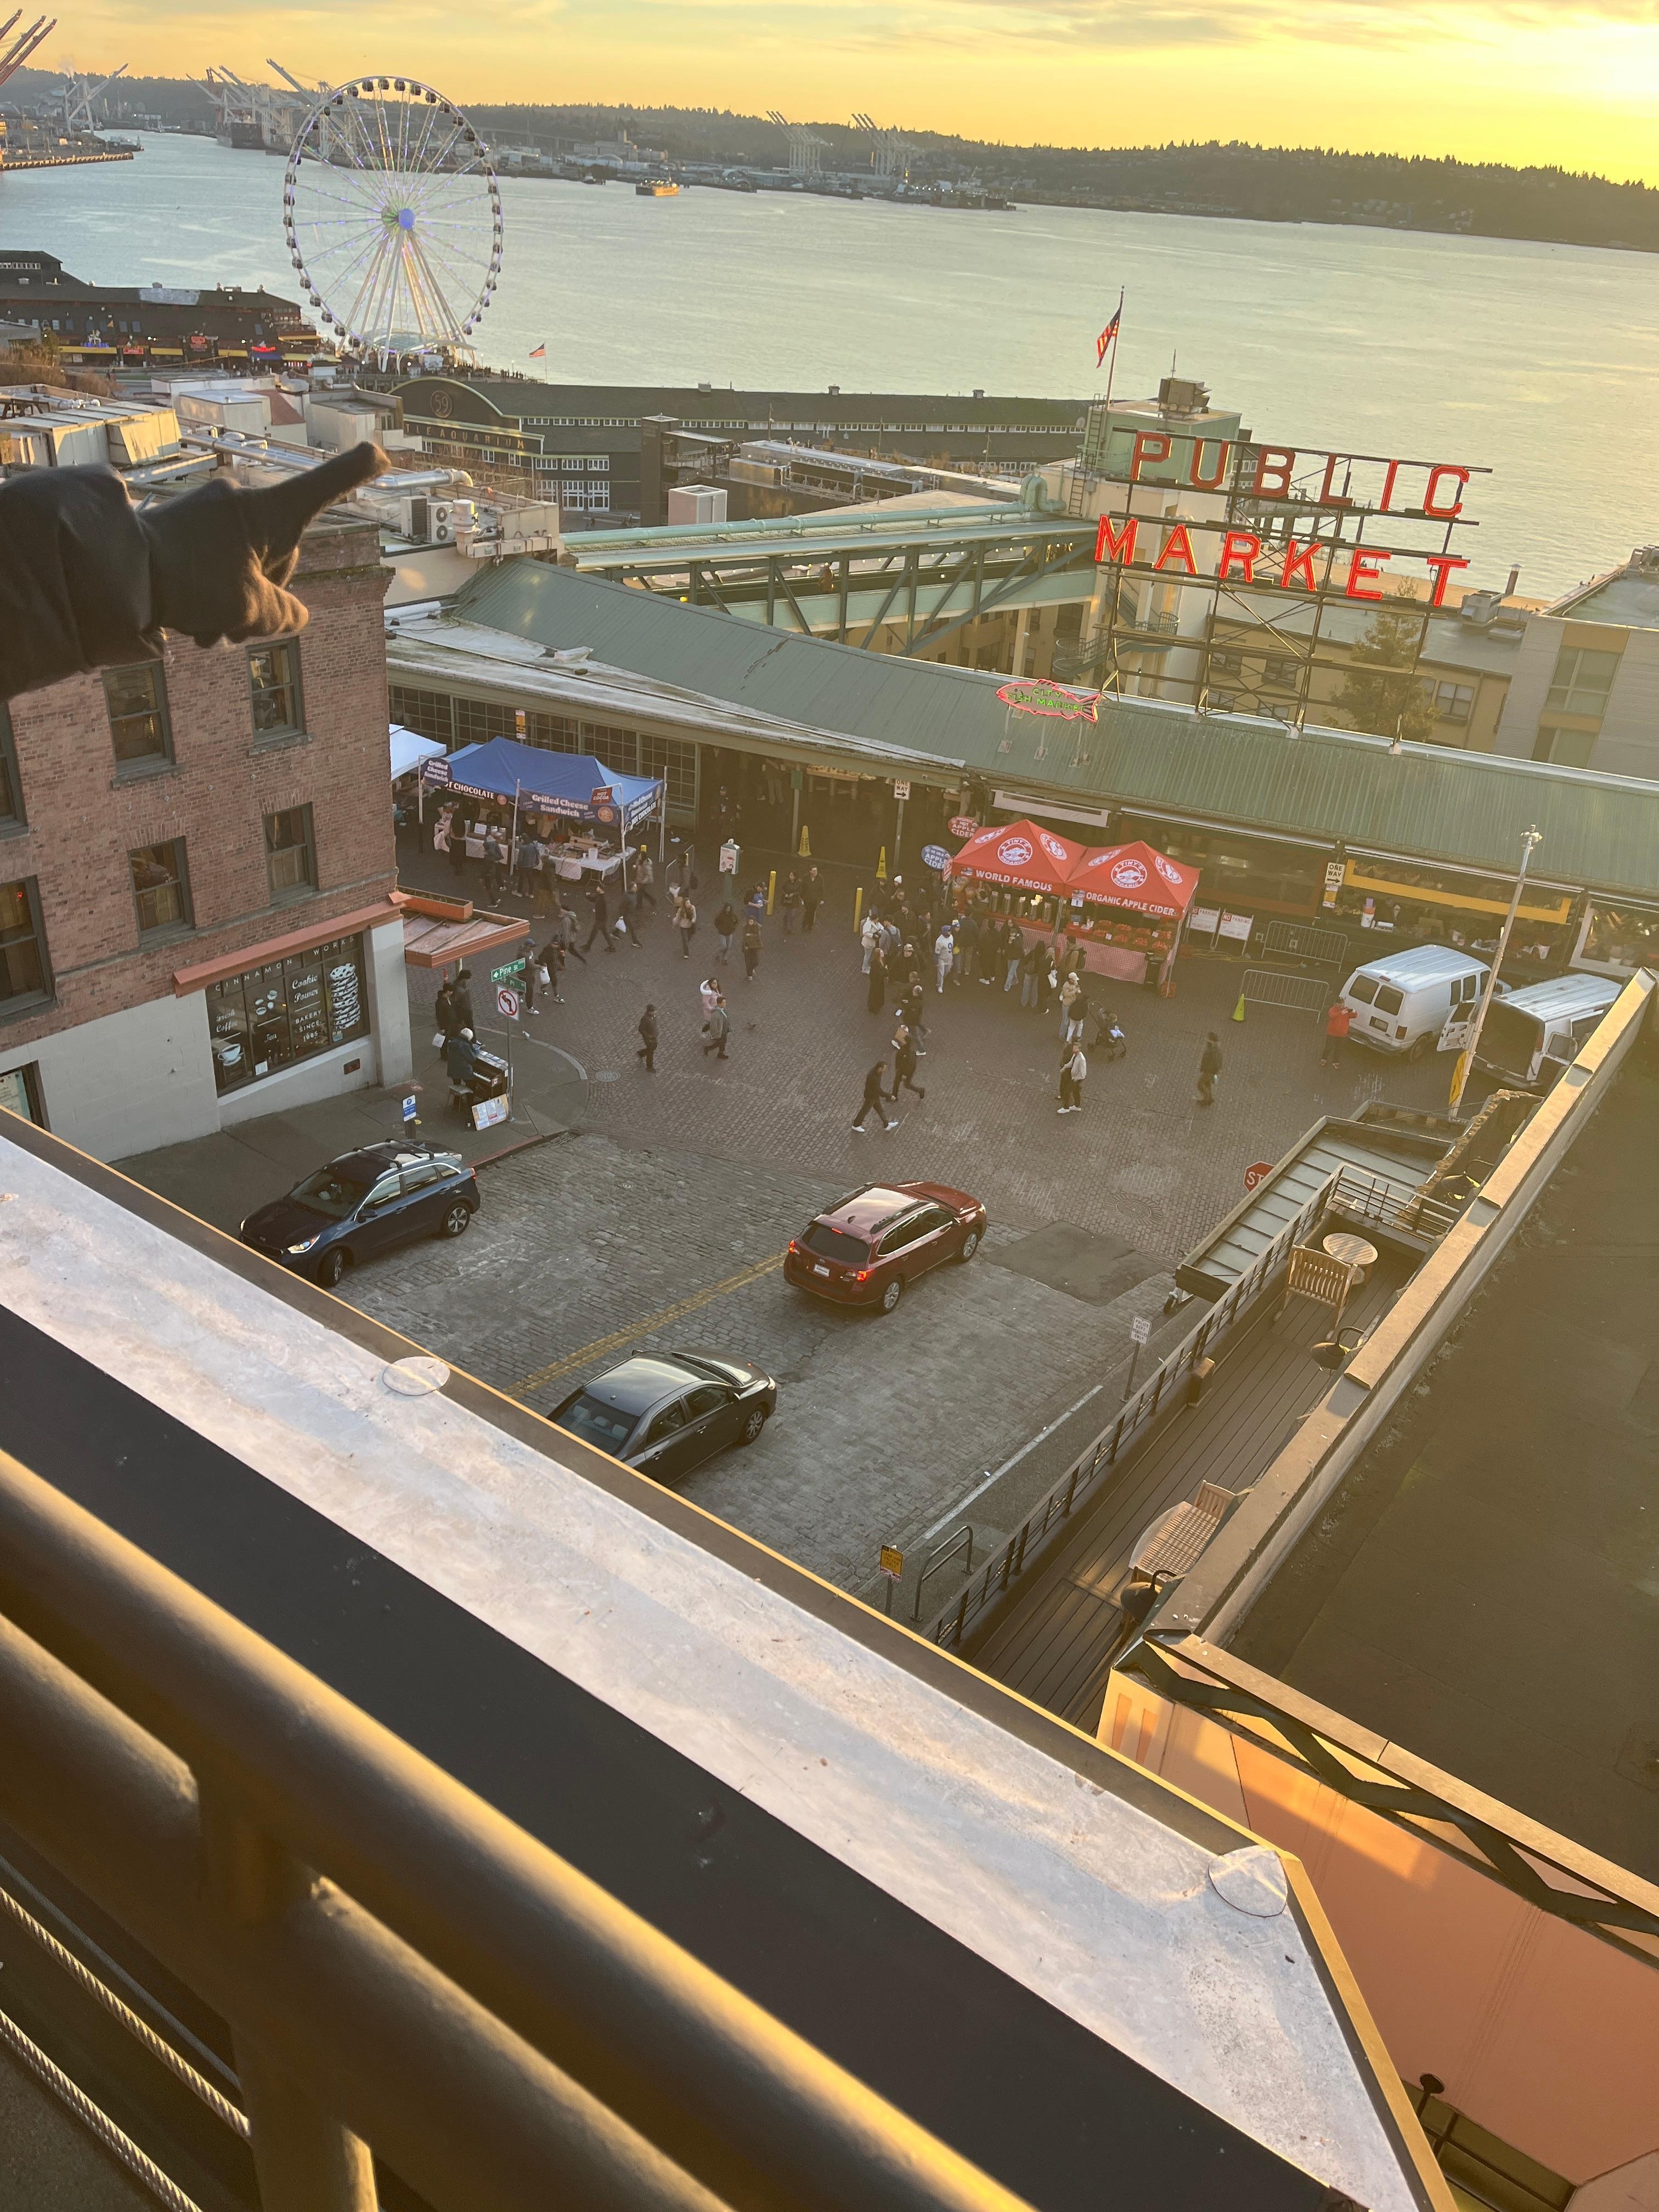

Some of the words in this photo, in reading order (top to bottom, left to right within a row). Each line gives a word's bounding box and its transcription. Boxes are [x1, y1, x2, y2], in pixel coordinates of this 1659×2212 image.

[435, 395, 449, 413] 59
[440, 428, 524, 449] AQUARIUM
[1131, 431, 1470, 518] PUBLIC
[1094, 514, 1469, 607] MARKET
[1006, 693, 1032, 703] FISH
[1032, 687, 1063, 698] CITY
[427, 766, 448, 775] Cheese
[428, 760, 448, 770] Grilled
[424, 771, 448, 782] Sandwich
[453, 782, 494, 799] CHOCOLATE
[532, 794, 560, 806] Grilled
[560, 800, 589, 810] Cheese
[540, 804, 580, 817] Sandwich
[951, 828, 974, 837] CIDER
[952, 824, 975, 832] APPLE
[1006, 838, 1030, 848] TINY'S
[925, 853, 947, 865] APPLE
[1000, 855, 1025, 865] ORGANIC
[1120, 860, 1145, 871] TINY'S
[976, 870, 1011, 883] WORLD
[1012, 877, 1053, 891] FAMOUS
[1114, 877, 1139, 888] ORGANIC
[1086, 891, 1121, 906] ORGANIC
[1121, 899, 1147, 911] APPLE
[1149, 904, 1175, 916] CIDER
[1232, 915, 1251, 924] PARKING
[948, 943, 952, 953] 9
[216, 959, 292, 991] CINNAMON
[313, 936, 354, 956] WORKS
[499, 966, 511, 977] Pine
[292, 974, 318, 990] Cookie
[294, 988, 318, 1003] Power
[216, 1008, 235, 1022] Fresh
[295, 1009, 322, 1024] BAKERY
[216, 1020, 238, 1033] Coffee
[299, 1020, 321, 1032] SINCE
[264, 1033, 277, 1042] Tea
[1247, 1171, 1265, 1186] ST
[1135, 1319, 1149, 1328] POLICE
